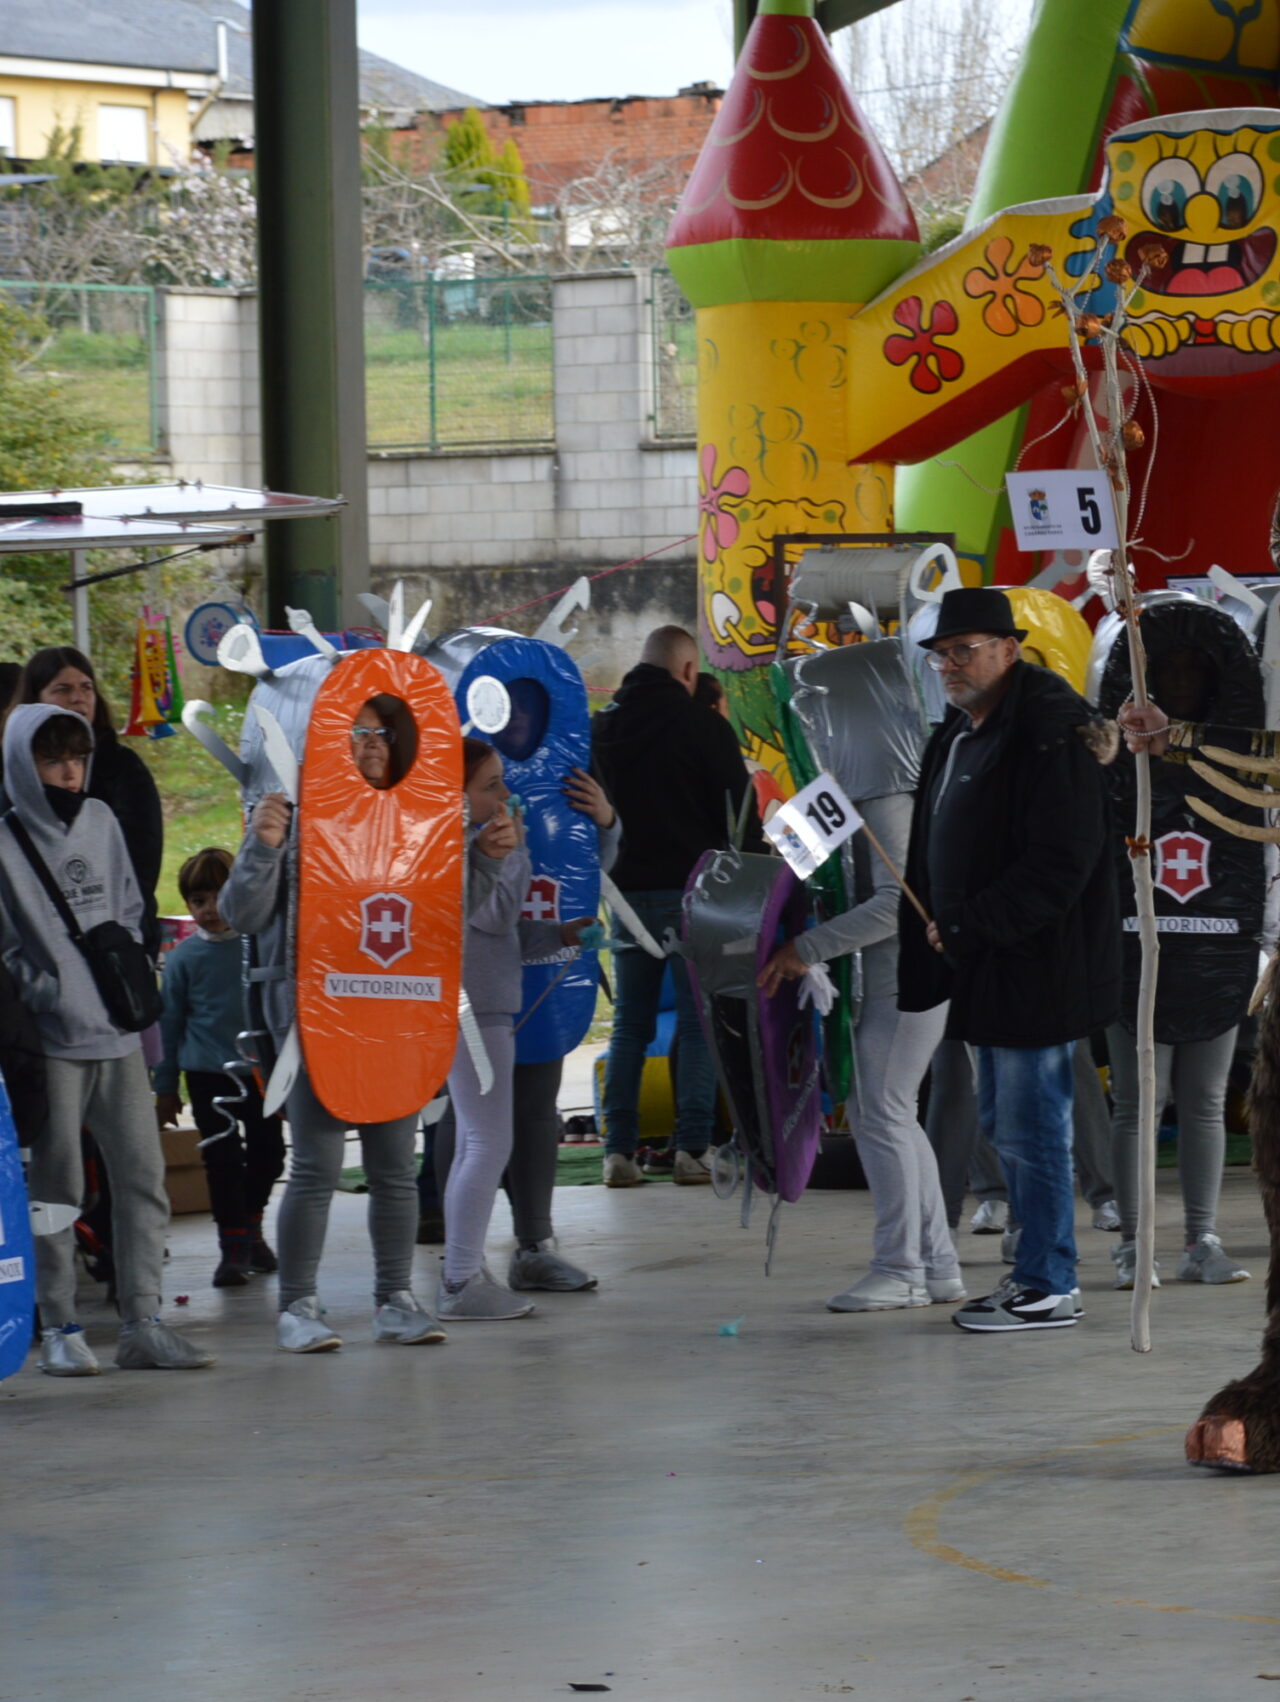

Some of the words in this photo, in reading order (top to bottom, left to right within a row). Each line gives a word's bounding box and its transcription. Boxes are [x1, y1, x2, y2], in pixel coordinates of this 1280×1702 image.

[1077, 488, 1102, 535] 5
[806, 791, 846, 837] 19
[1124, 917, 1236, 933] VTORINOX
[329, 979, 435, 996] VICTORINOX
